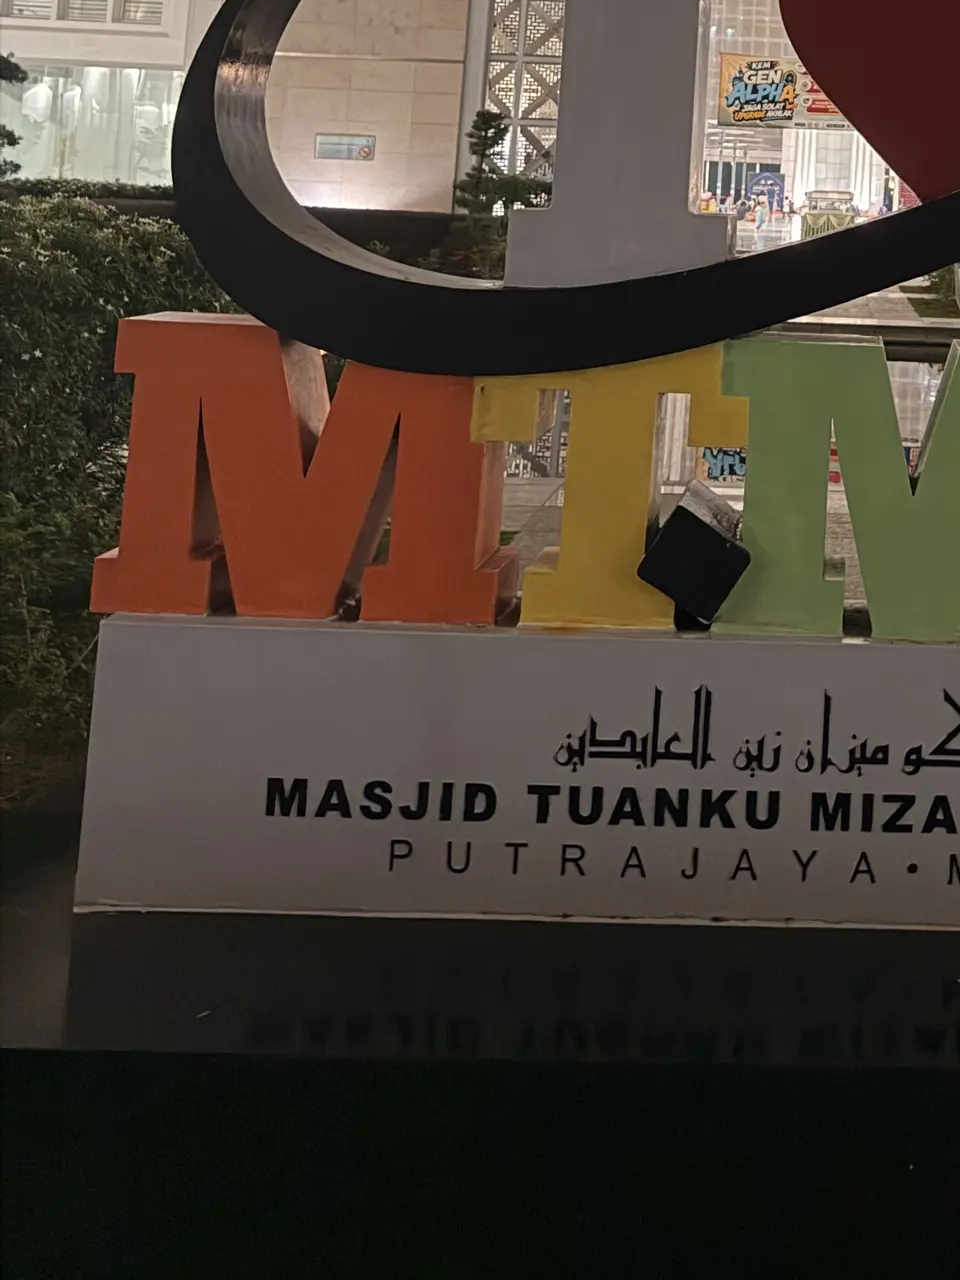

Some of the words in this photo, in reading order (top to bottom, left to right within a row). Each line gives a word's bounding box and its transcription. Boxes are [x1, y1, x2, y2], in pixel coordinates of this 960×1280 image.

[726, 81, 796, 107] ALPHA
[743, 69, 783, 84] GEN
[762, 102, 785, 110] SOLAT
[554, 684, 716, 773] العابدين
[795, 690, 890, 777] ميزان
[733, 730, 782, 778] زين
[265, 777, 497, 822] MASJID
[527, 784, 781, 830] TUANKU
[388, 839, 877, 885] PUTRAJAYA
